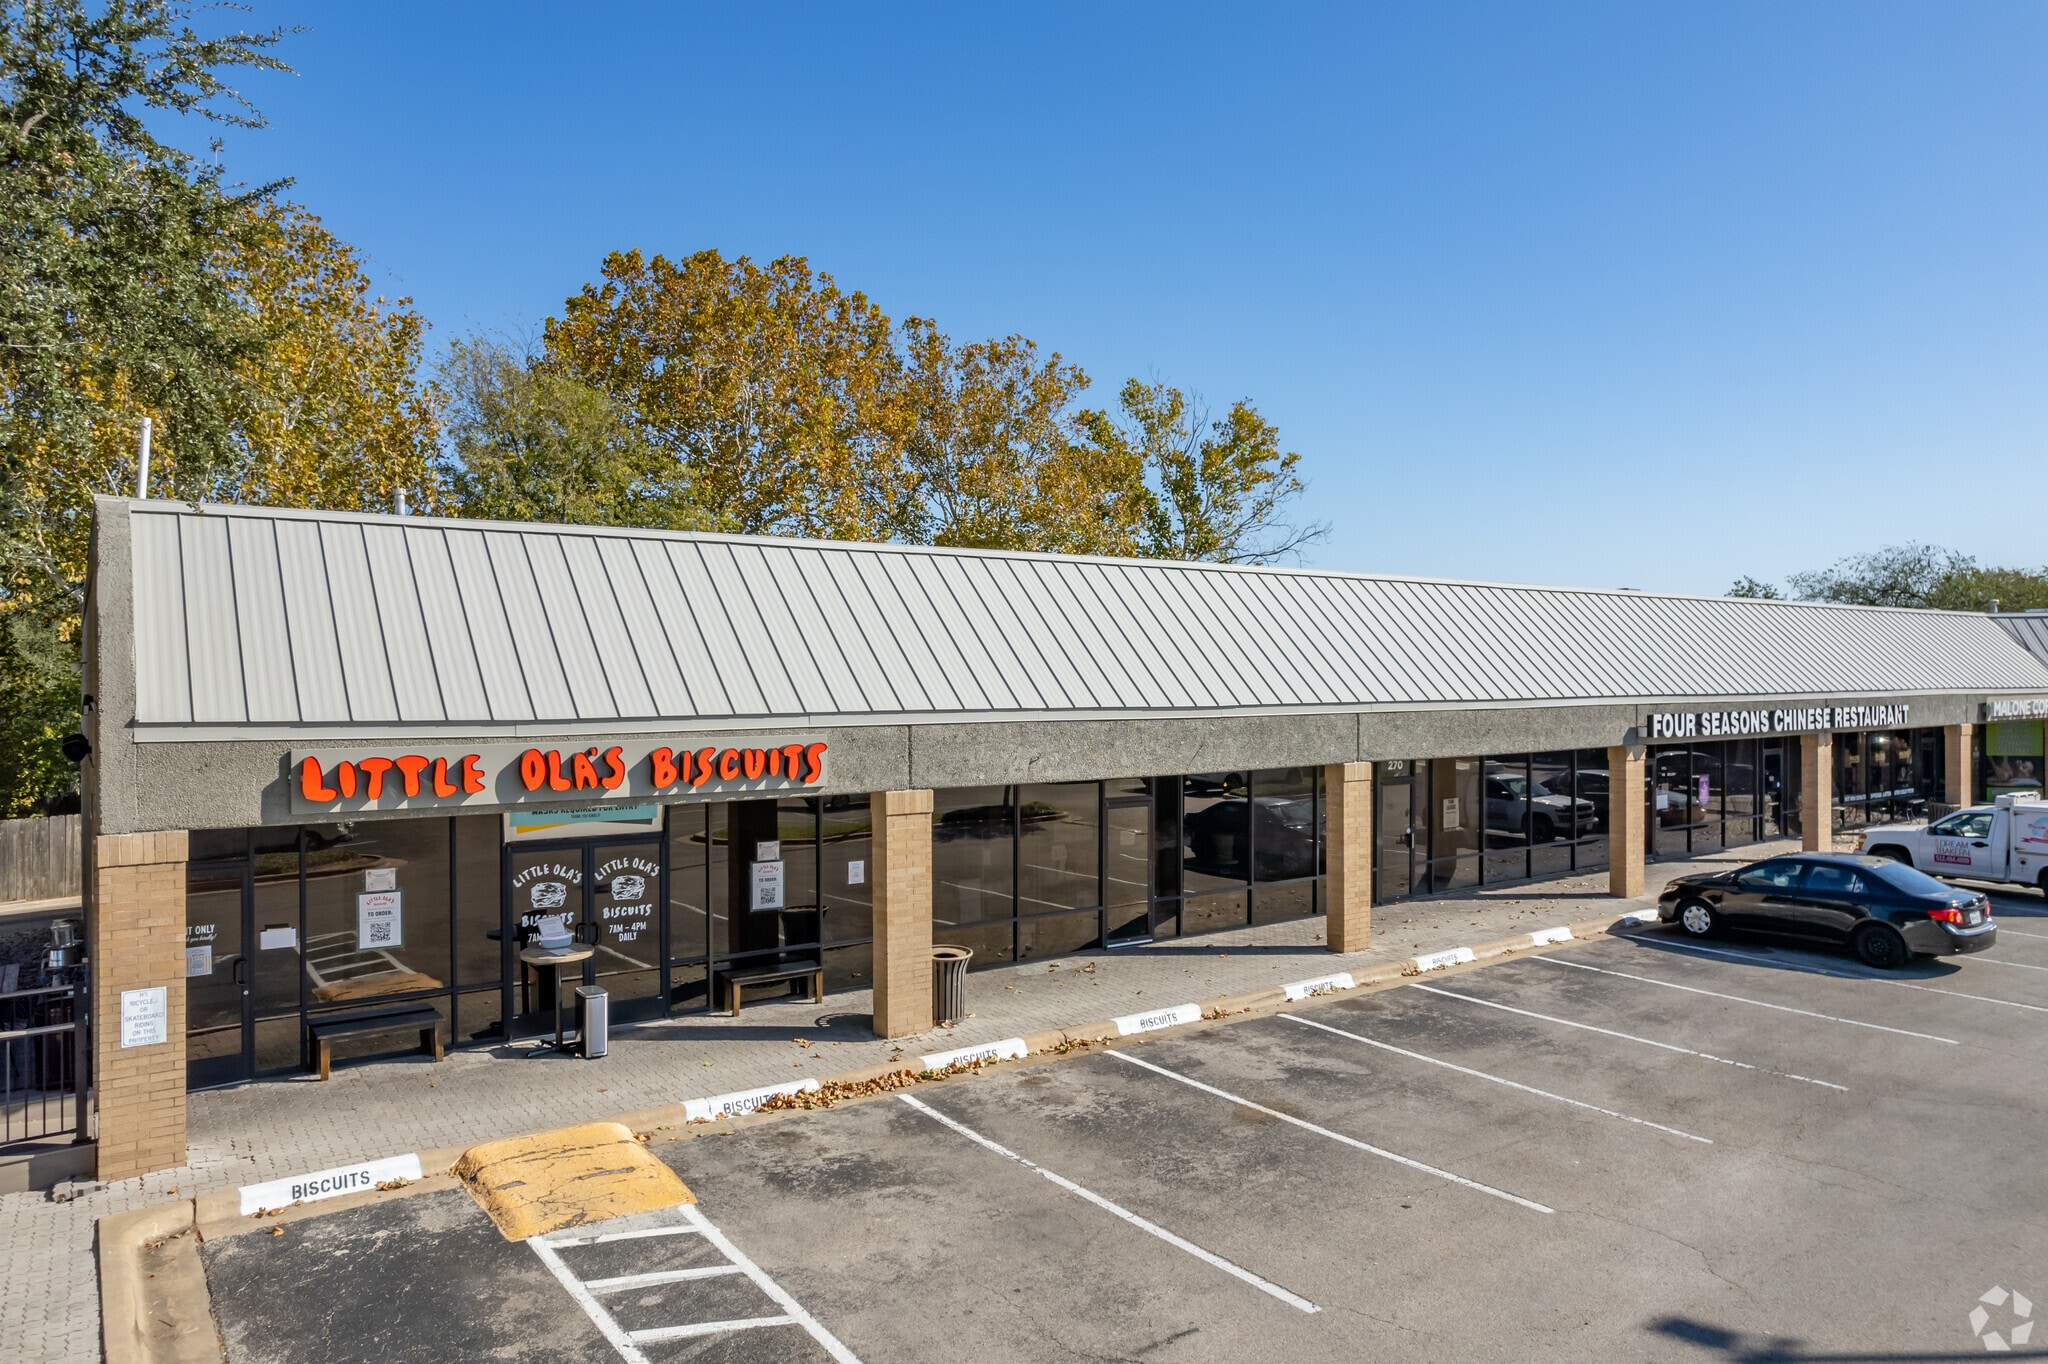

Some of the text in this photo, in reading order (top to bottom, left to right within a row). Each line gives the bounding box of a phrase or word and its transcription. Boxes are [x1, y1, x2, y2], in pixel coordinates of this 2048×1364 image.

[1993, 700, 2031, 716] MALONE
[1653, 704, 1909, 738] FOUR SEASONS CHINESE RESTAURANT
[301, 742, 828, 803] LITTLE OLA'S BISCUITS
[1387, 760, 1404, 771] 270
[512, 863, 582, 888] LITTLE OLA'S
[594, 857, 660, 881] LITTLE OLA'S
[602, 903, 653, 919] BISCUITS
[521, 911, 575, 928] BISTS
[609, 923, 624, 934] 7AM
[631, 921, 647, 931] 4PM
[194, 924, 215, 935] ONLY
[619, 932, 637, 942] DAILY
[125, 1012, 164, 1022] SKATEBOARD
[1140, 1011, 1178, 1029] BISCUITS
[129, 1035, 159, 1044] PROPERTY
[723, 1093, 780, 1115] BISCUIT
[291, 1171, 370, 1200] BISCUITS
